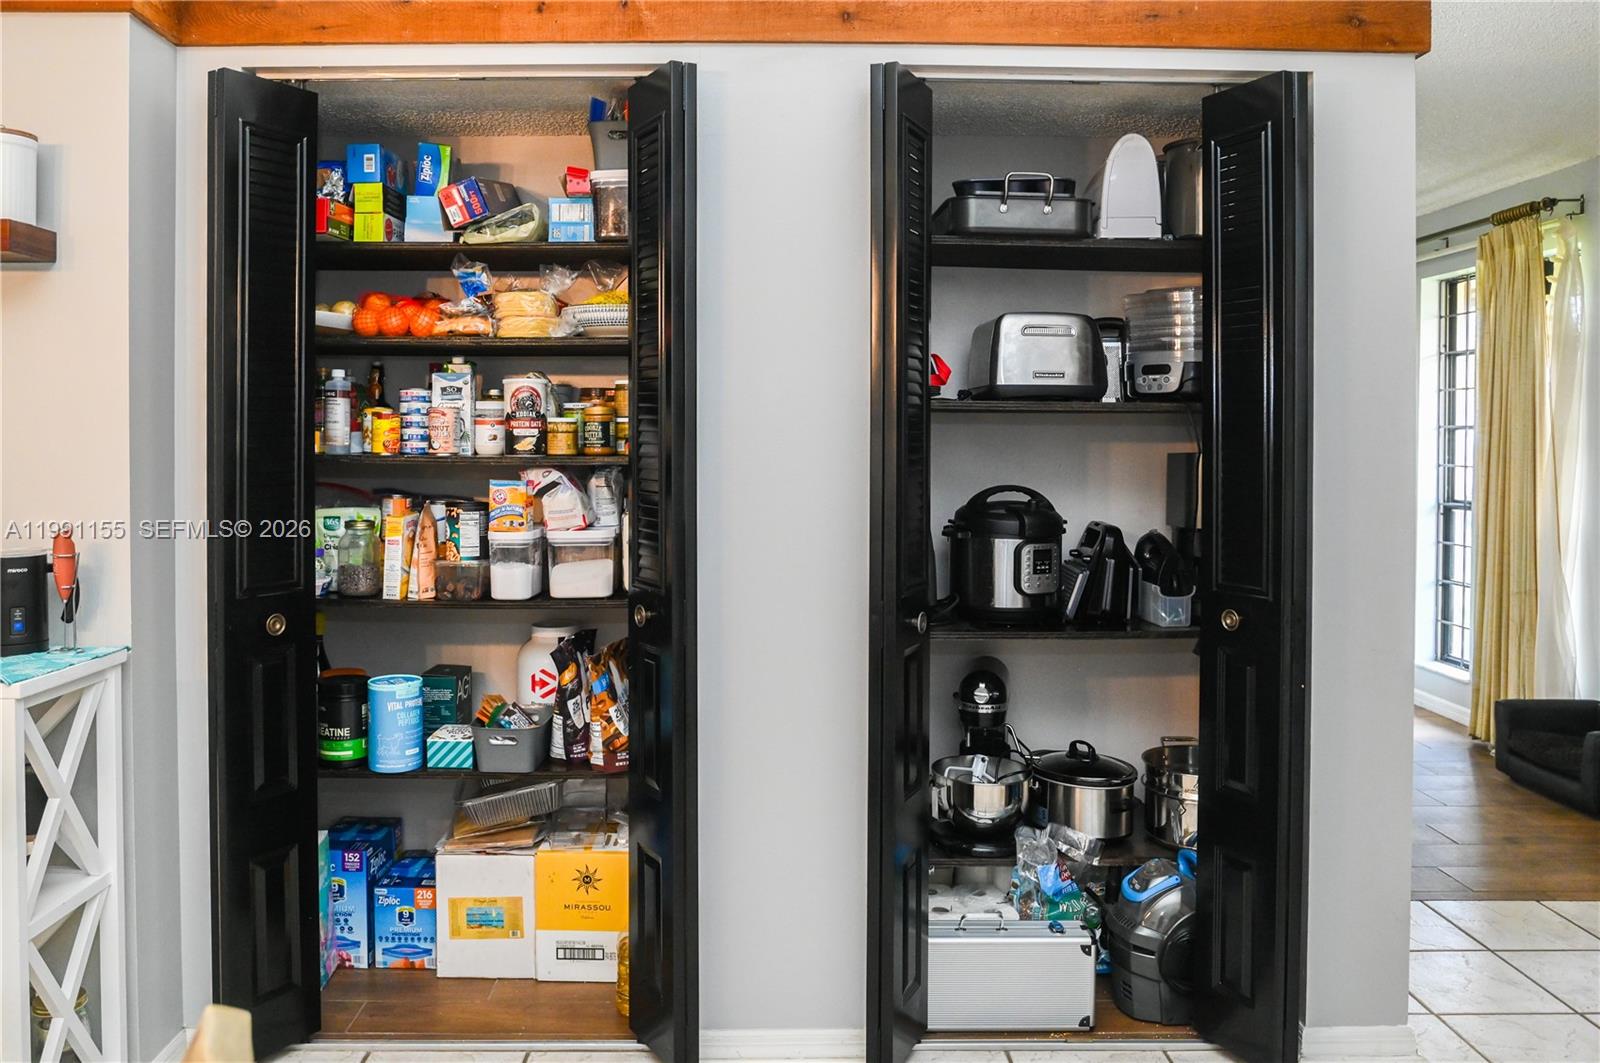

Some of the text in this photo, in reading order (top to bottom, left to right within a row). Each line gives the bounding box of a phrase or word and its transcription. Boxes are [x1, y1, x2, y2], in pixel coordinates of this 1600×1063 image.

[419, 153, 432, 182] Ziploc
[387, 700, 404, 713] VITAL
[320, 727, 351, 737] EATINE
[344, 852, 360, 862] 152
[416, 890, 433, 899] 216
[378, 895, 401, 906] Ziploc
[563, 903, 612, 911] MIRASSOU
[403, 910, 410, 918] 9
